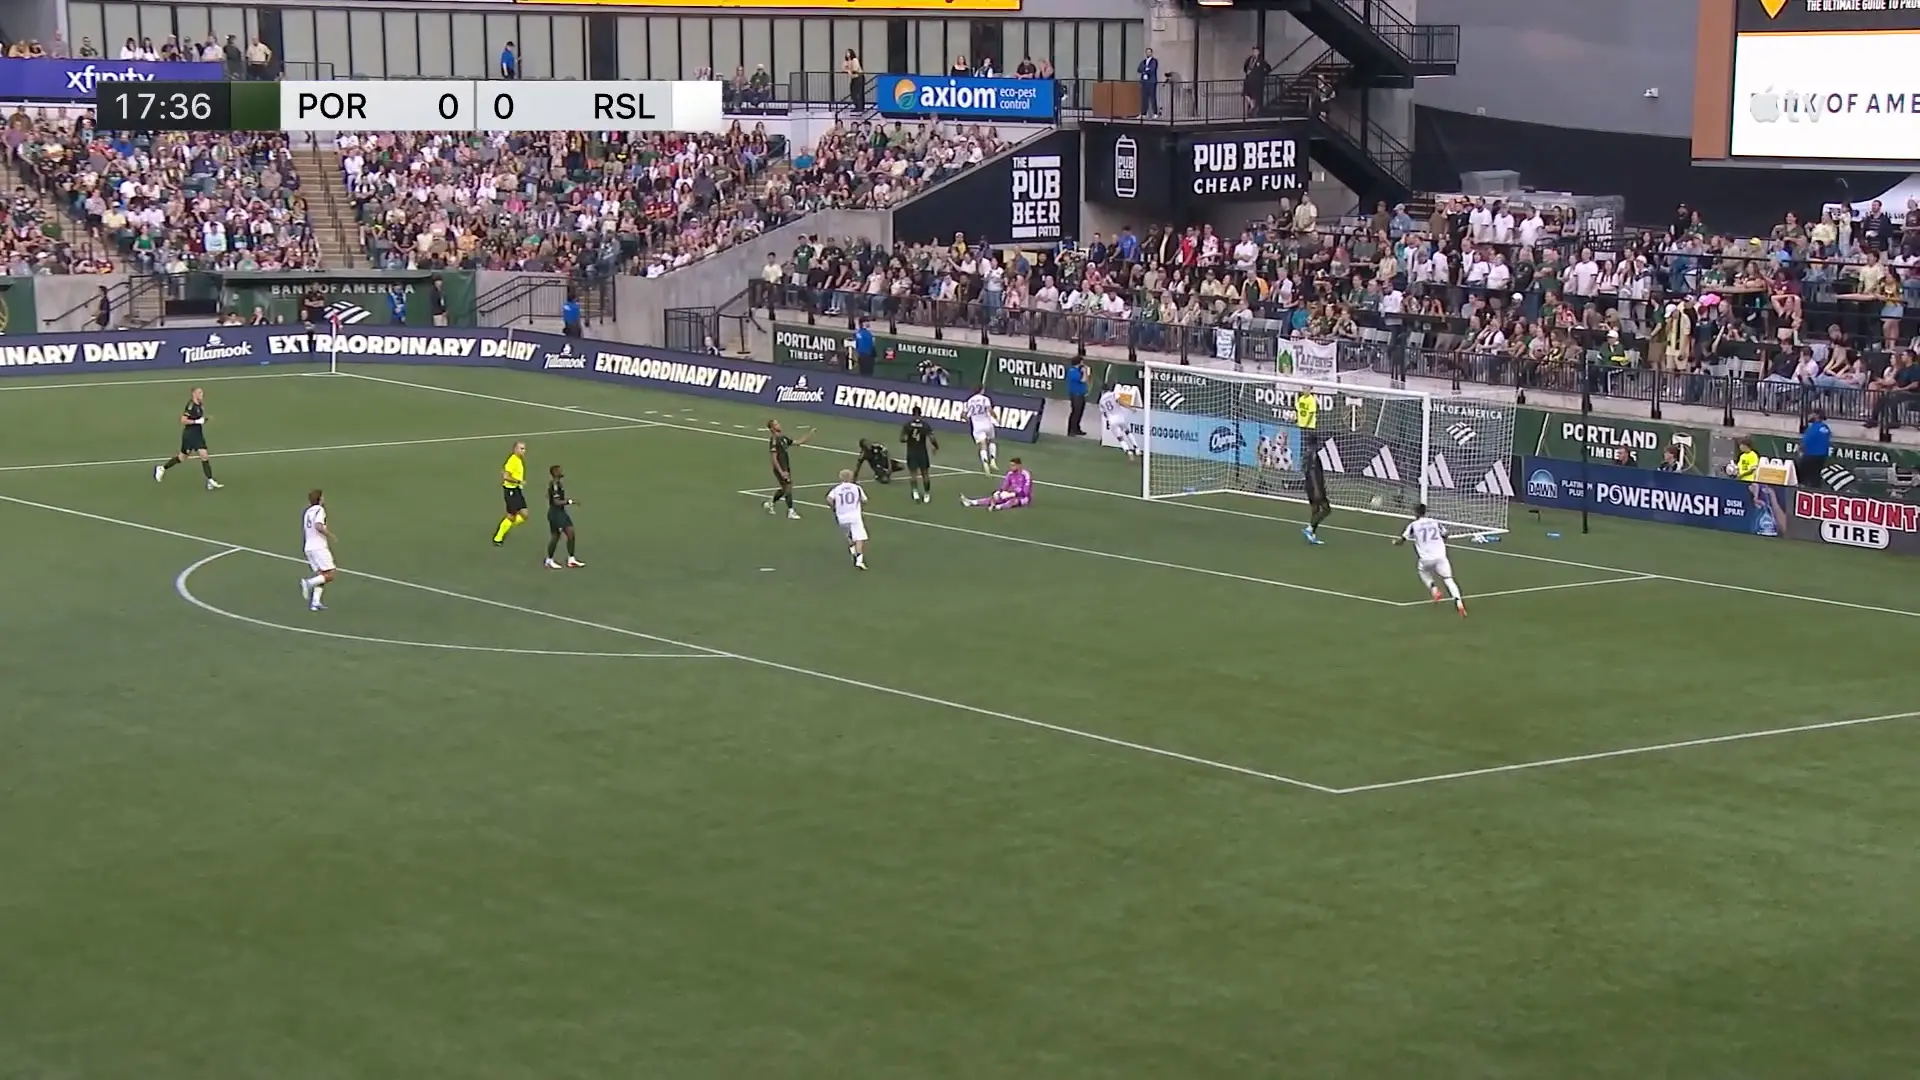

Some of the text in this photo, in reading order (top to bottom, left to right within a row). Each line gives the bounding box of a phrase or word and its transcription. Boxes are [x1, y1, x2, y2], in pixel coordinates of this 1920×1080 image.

[1807, 0, 1821, 11] THE
[1822, 0, 1861, 11] ULTIMATE
[1862, 0, 1886, 10] GUIDE
[920, 79, 996, 109] axiom
[1000, 87, 1036, 100] eco-pest
[1000, 99, 1030, 109] control
[1826, 93, 1858, 113] OF
[1012, 157, 1028, 168] THE
[1118, 156, 1134, 169] PUB
[1193, 140, 1296, 173] PUB BEER
[1118, 169, 1134, 180] BEER
[1012, 169, 1061, 200] PUB
[1193, 173, 1303, 195] CHEAP FUN.
[1012, 201, 1060, 225] BEER
[1038, 225, 1060, 238] PATIO
[319, 284, 338, 294] OF
[342, 283, 415, 295] AMERIA
[268, 333, 537, 361] EXTRAORDINARY DAIRY
[776, 331, 836, 352] PORTLAND
[897, 343, 958, 358] BANK OF AMERICA
[83, 341, 160, 363] DAIRY
[180, 341, 252, 364] Tillamook
[544, 352, 587, 370] Tillamook
[594, 352, 768, 395] EXTRAORDINARY DAIRY
[998, 357, 1066, 380] PORTLAND
[1012, 376, 1053, 391] TIMBERS
[775, 383, 825, 403] Tillamook
[1255, 387, 1334, 411] PORTLND
[969, 403, 985, 416] 22
[989, 405, 1035, 431] AIRY
[1130, 422, 1144, 436] THE
[1562, 422, 1658, 450] PORTLAND
[1586, 445, 1638, 462] IMBES
[1836, 447, 1890, 464] AMERICA
[1528, 481, 1558, 499] DAWN
[1561, 479, 1593, 491] PLATINM
[838, 491, 855, 506] 10
[1596, 483, 1719, 517] POWERWASH
[1726, 499, 1743, 508] DISH
[1723, 506, 1746, 517] SPRAY
[1796, 490, 1919, 532] DISCOUNT
[1420, 526, 1439, 542] 72
[1828, 523, 1881, 545] TIRE
